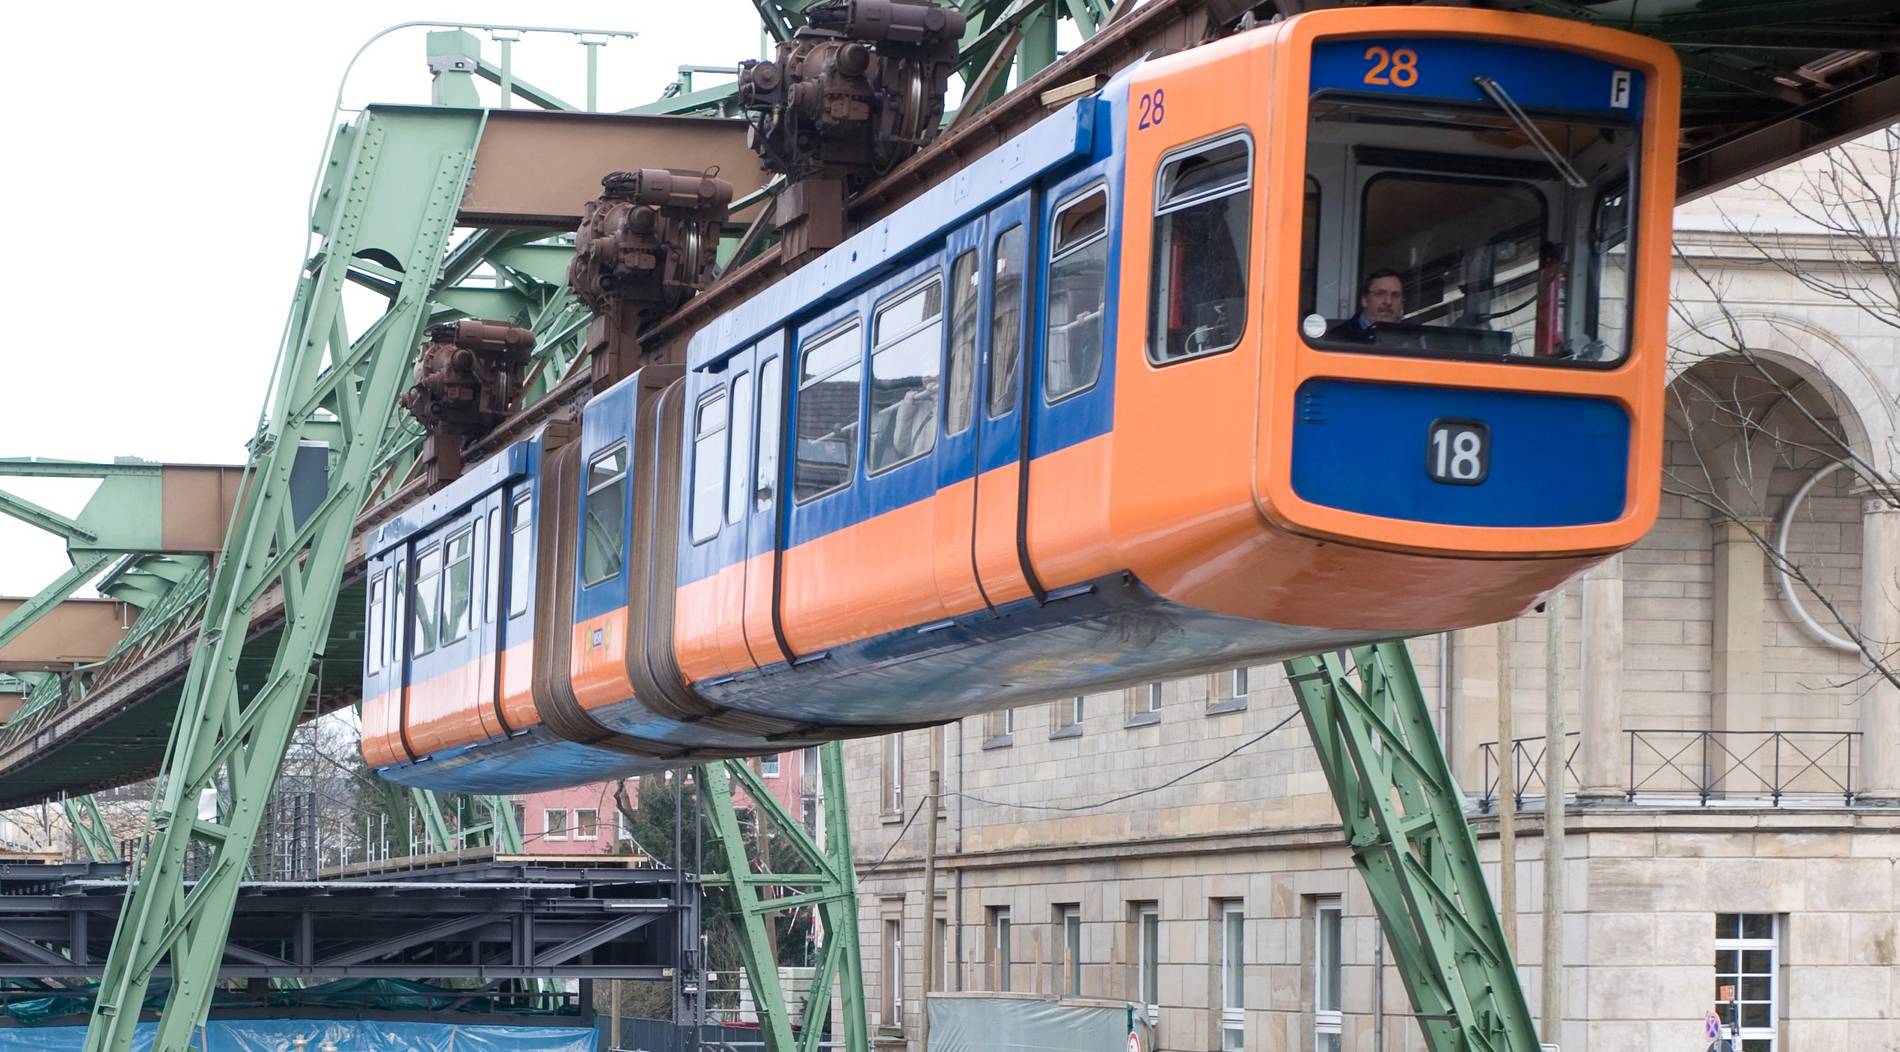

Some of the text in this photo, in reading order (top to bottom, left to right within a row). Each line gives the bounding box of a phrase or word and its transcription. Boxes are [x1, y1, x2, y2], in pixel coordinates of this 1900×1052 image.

[1363, 46, 1419, 87] 28
[1138, 88, 1165, 131] 28
[1615, 77, 1627, 102] F
[1433, 429, 1481, 480] 18
